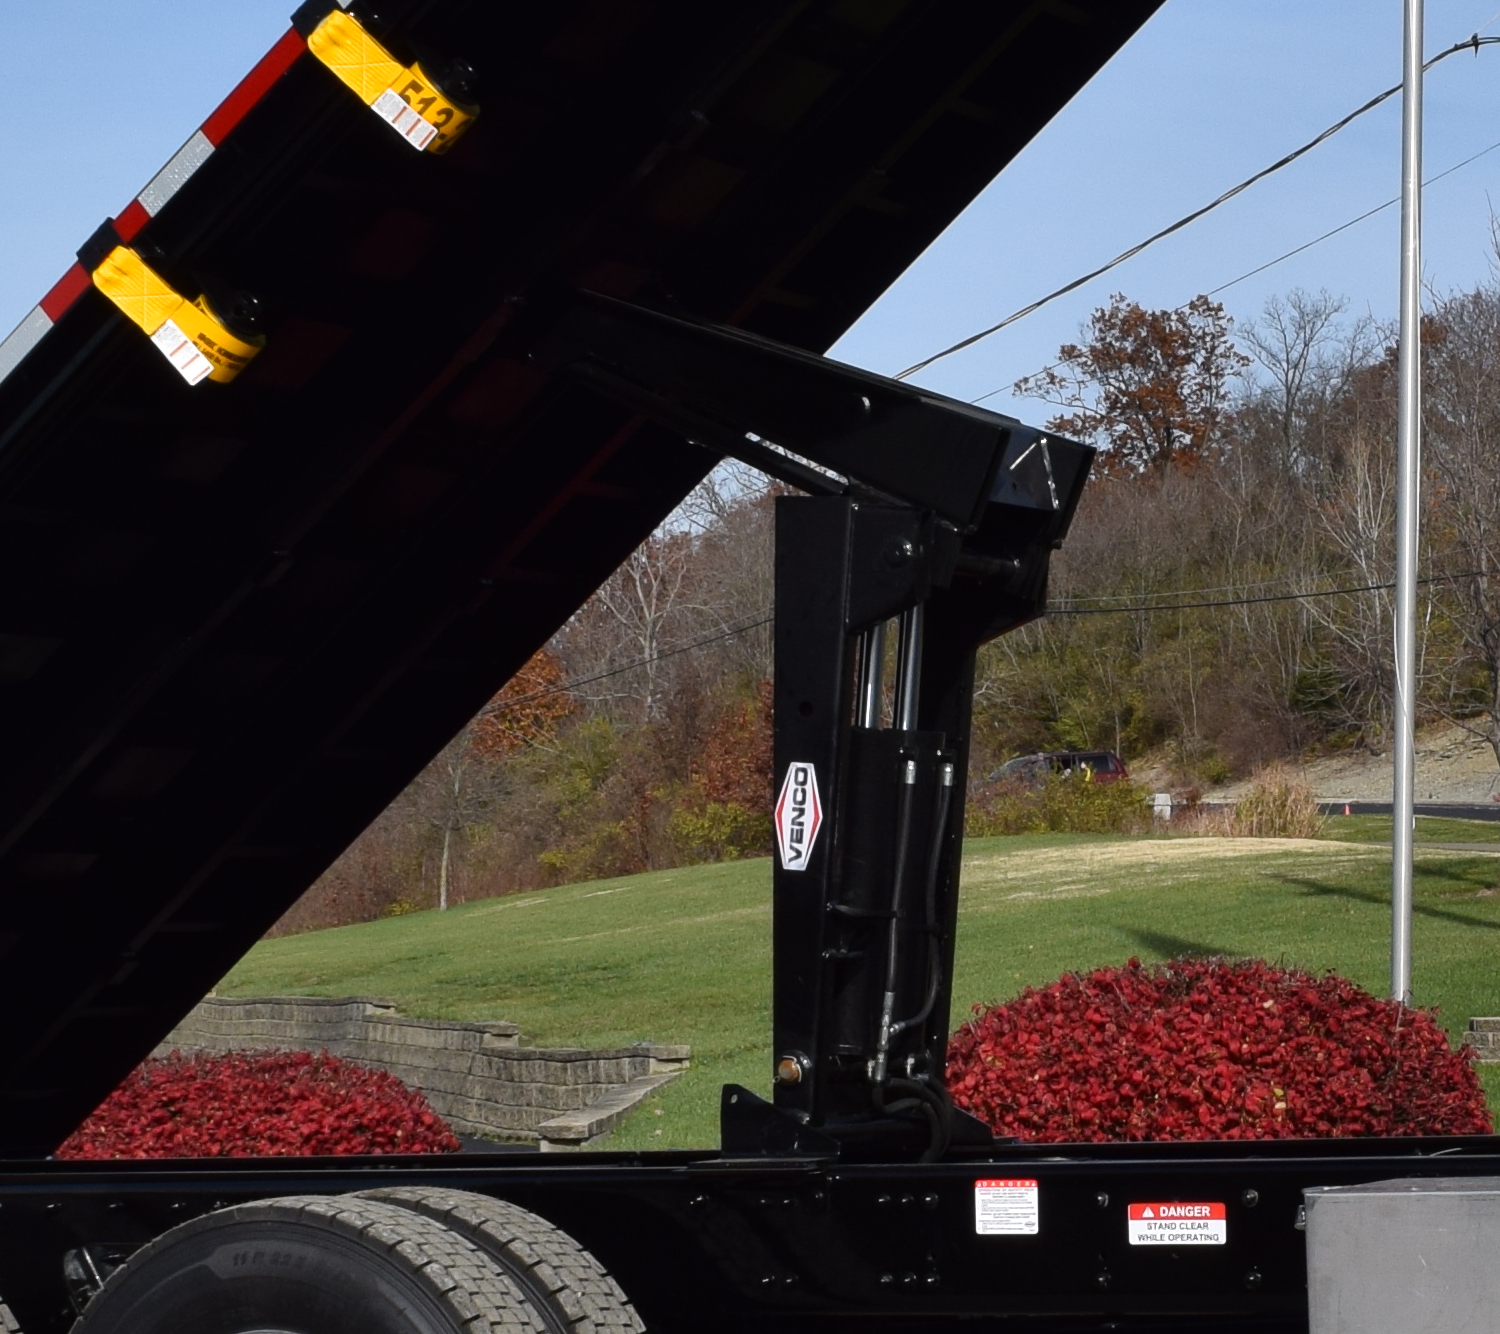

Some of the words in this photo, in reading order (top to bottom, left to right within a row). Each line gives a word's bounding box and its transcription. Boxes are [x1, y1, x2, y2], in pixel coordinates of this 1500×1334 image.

[788, 766, 809, 864] VENCO
[1160, 1206, 1211, 1217] DANGER
[1146, 1222, 1177, 1230] STAND
[1179, 1222, 1209, 1230] CLEAR
[1137, 1233, 1165, 1241] WHILE
[1168, 1233, 1219, 1241] OPERATING
